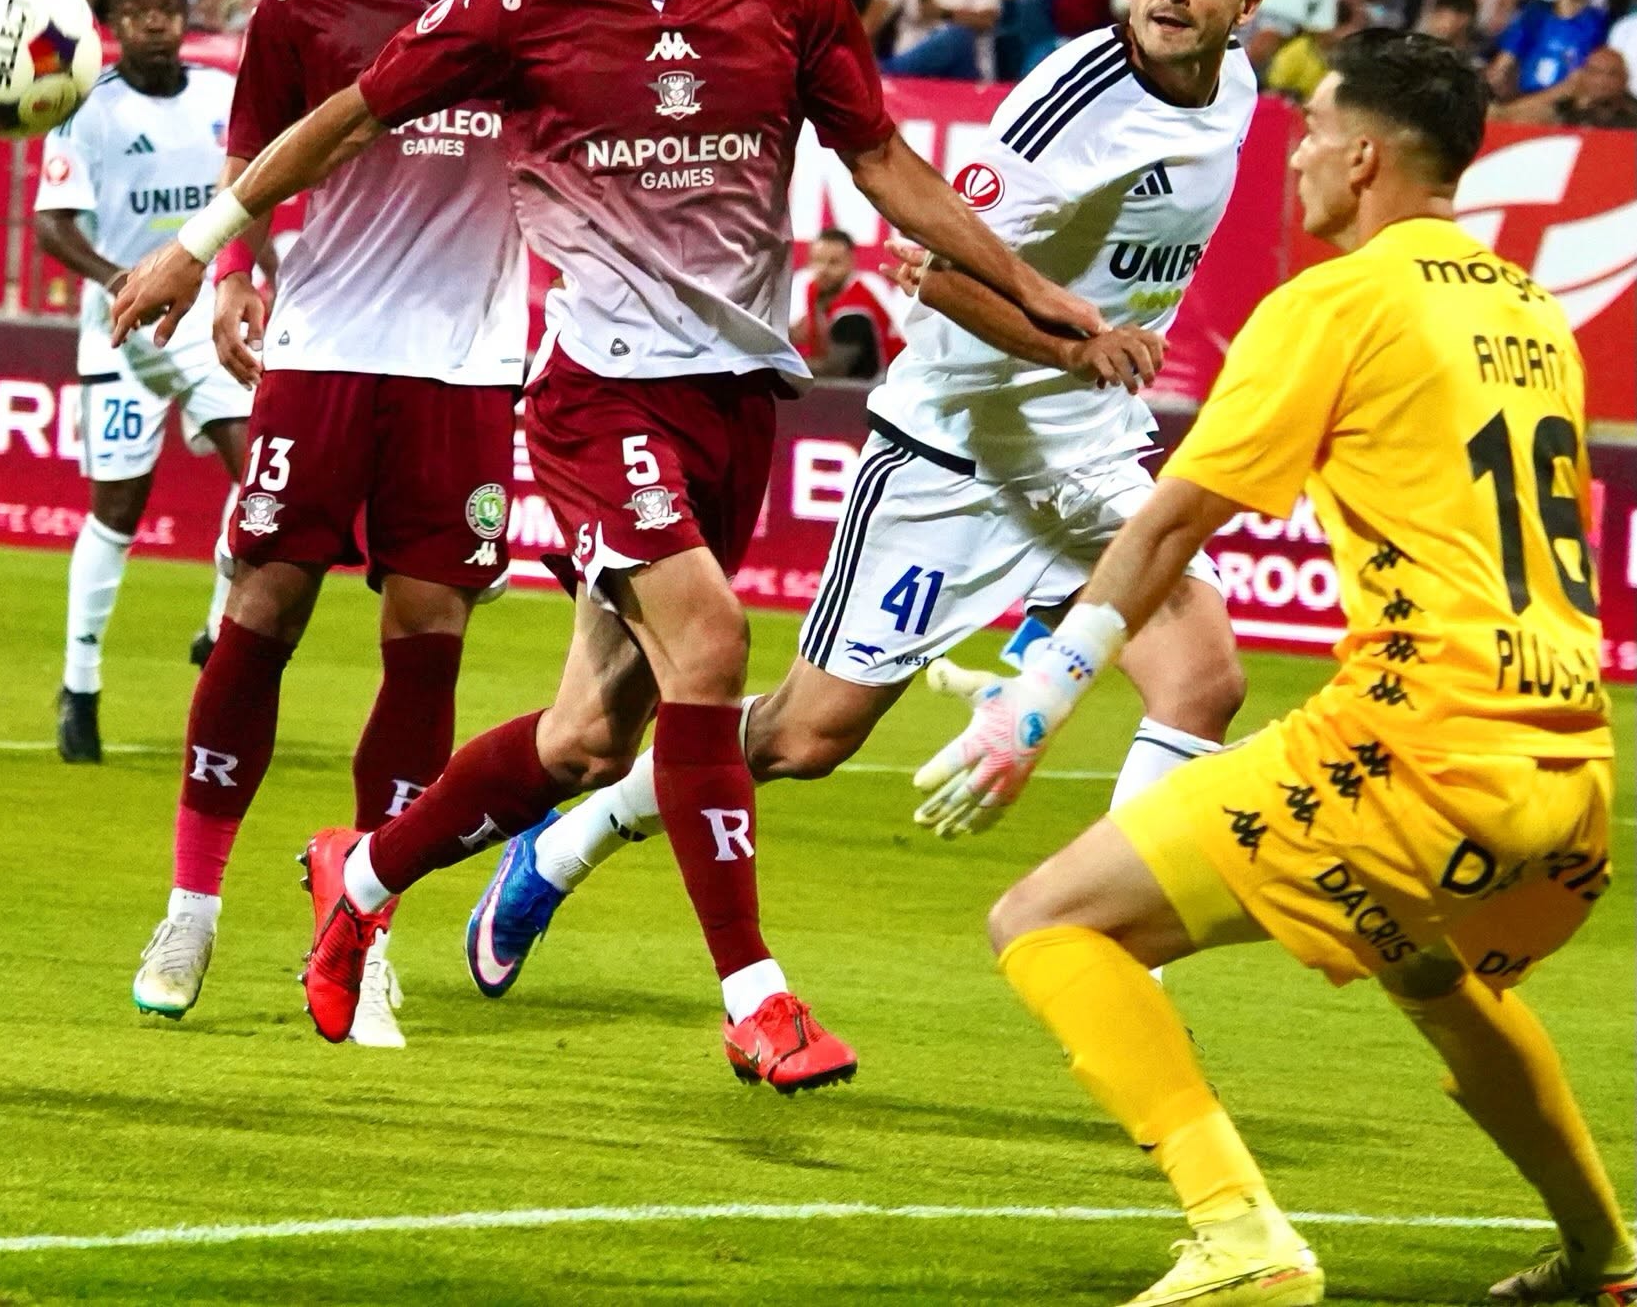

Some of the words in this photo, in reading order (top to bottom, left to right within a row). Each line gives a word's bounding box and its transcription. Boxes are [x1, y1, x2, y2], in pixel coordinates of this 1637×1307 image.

[401, 138, 465, 157] GAMES
[584, 132, 762, 168] NAPOLEON
[640, 167, 715, 189] GAMES
[103, 398, 143, 443] 26
[244, 435, 295, 493] 13
[622, 434, 661, 487] 5
[1465, 408, 1600, 620] 16
[880, 565, 945, 636] 41
[190, 744, 240, 788] R
[700, 807, 756, 862] R
[1314, 860, 1417, 964] DACRIS
